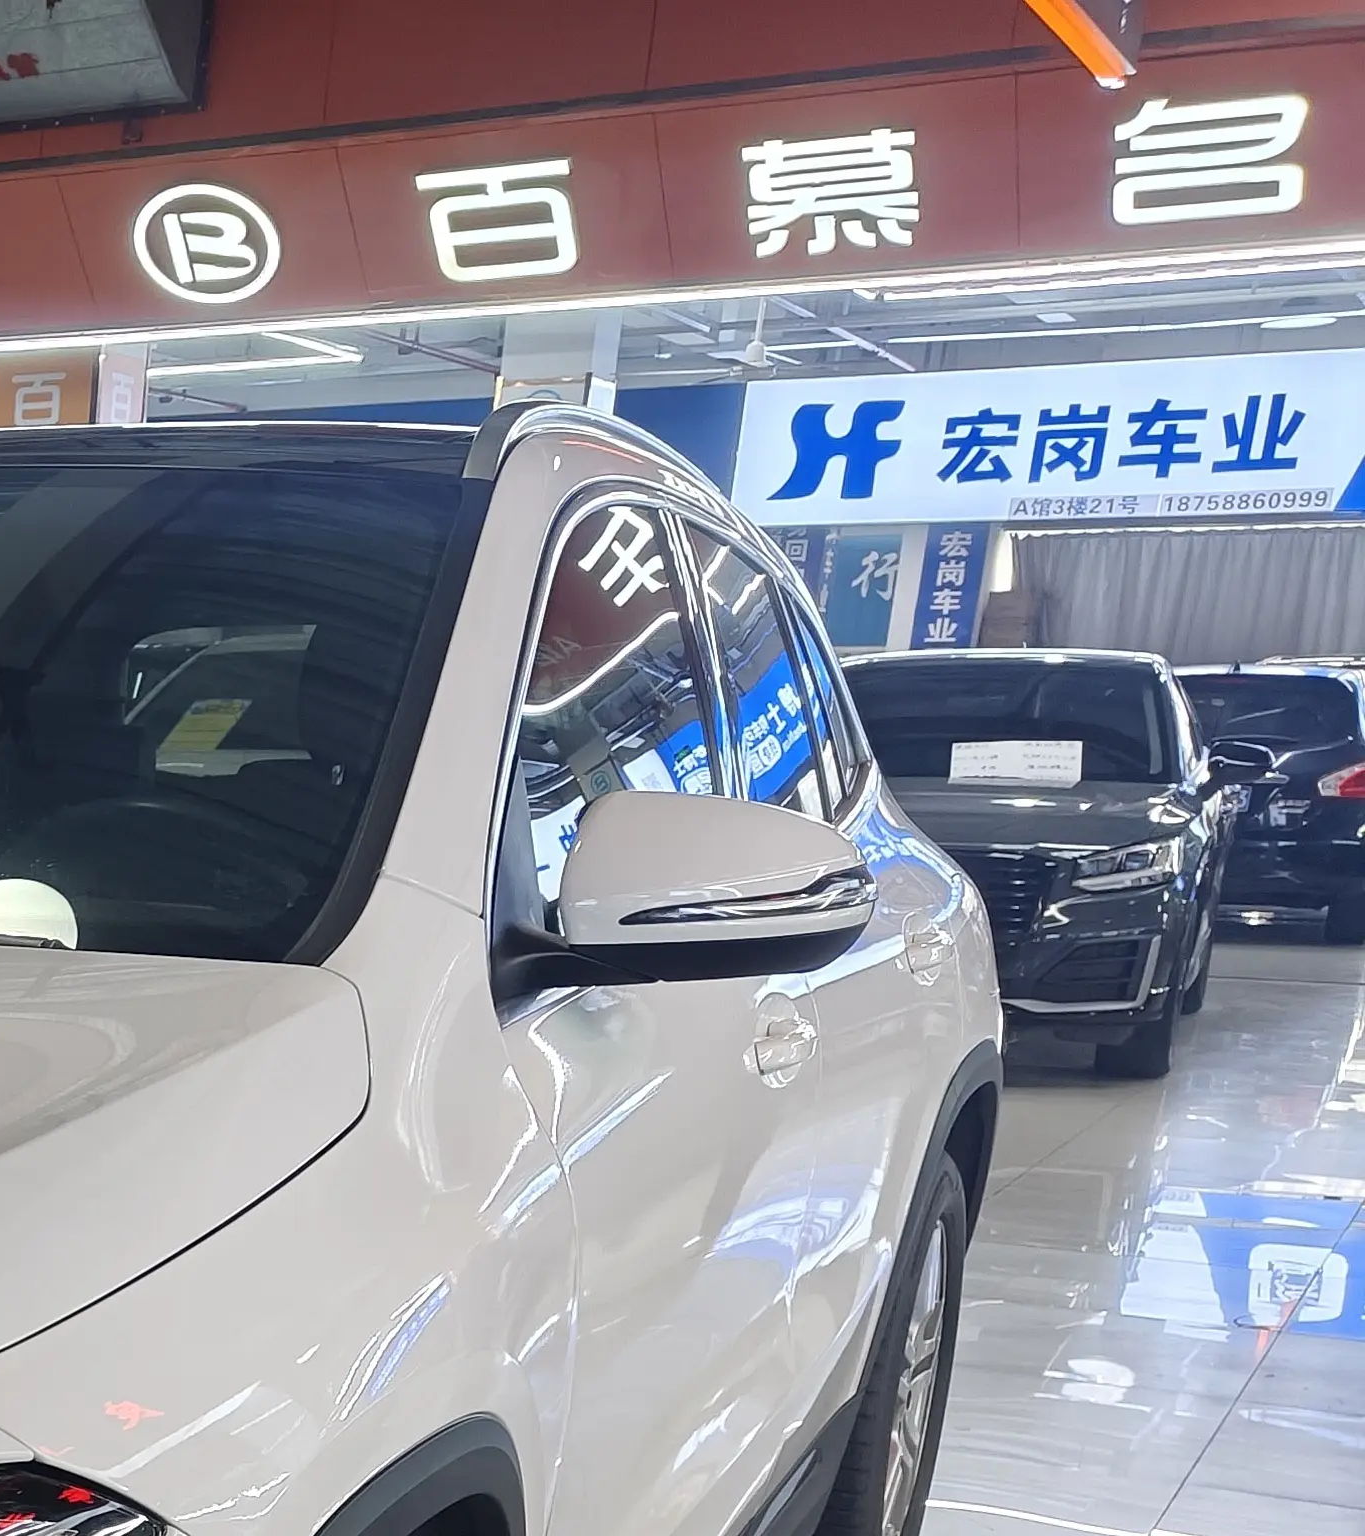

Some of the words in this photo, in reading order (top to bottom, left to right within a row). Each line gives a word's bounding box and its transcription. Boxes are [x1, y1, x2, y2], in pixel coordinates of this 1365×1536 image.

[415, 94, 1309, 283] 百慕名
[12, 371, 67, 426] 百
[937, 393, 1306, 484] 宏岗车业
[1013, 496, 1140, 517] A馆3楼21号
[1165, 490, 1329, 513] 18758860999
[924, 531, 972, 643] 宏岗车业
